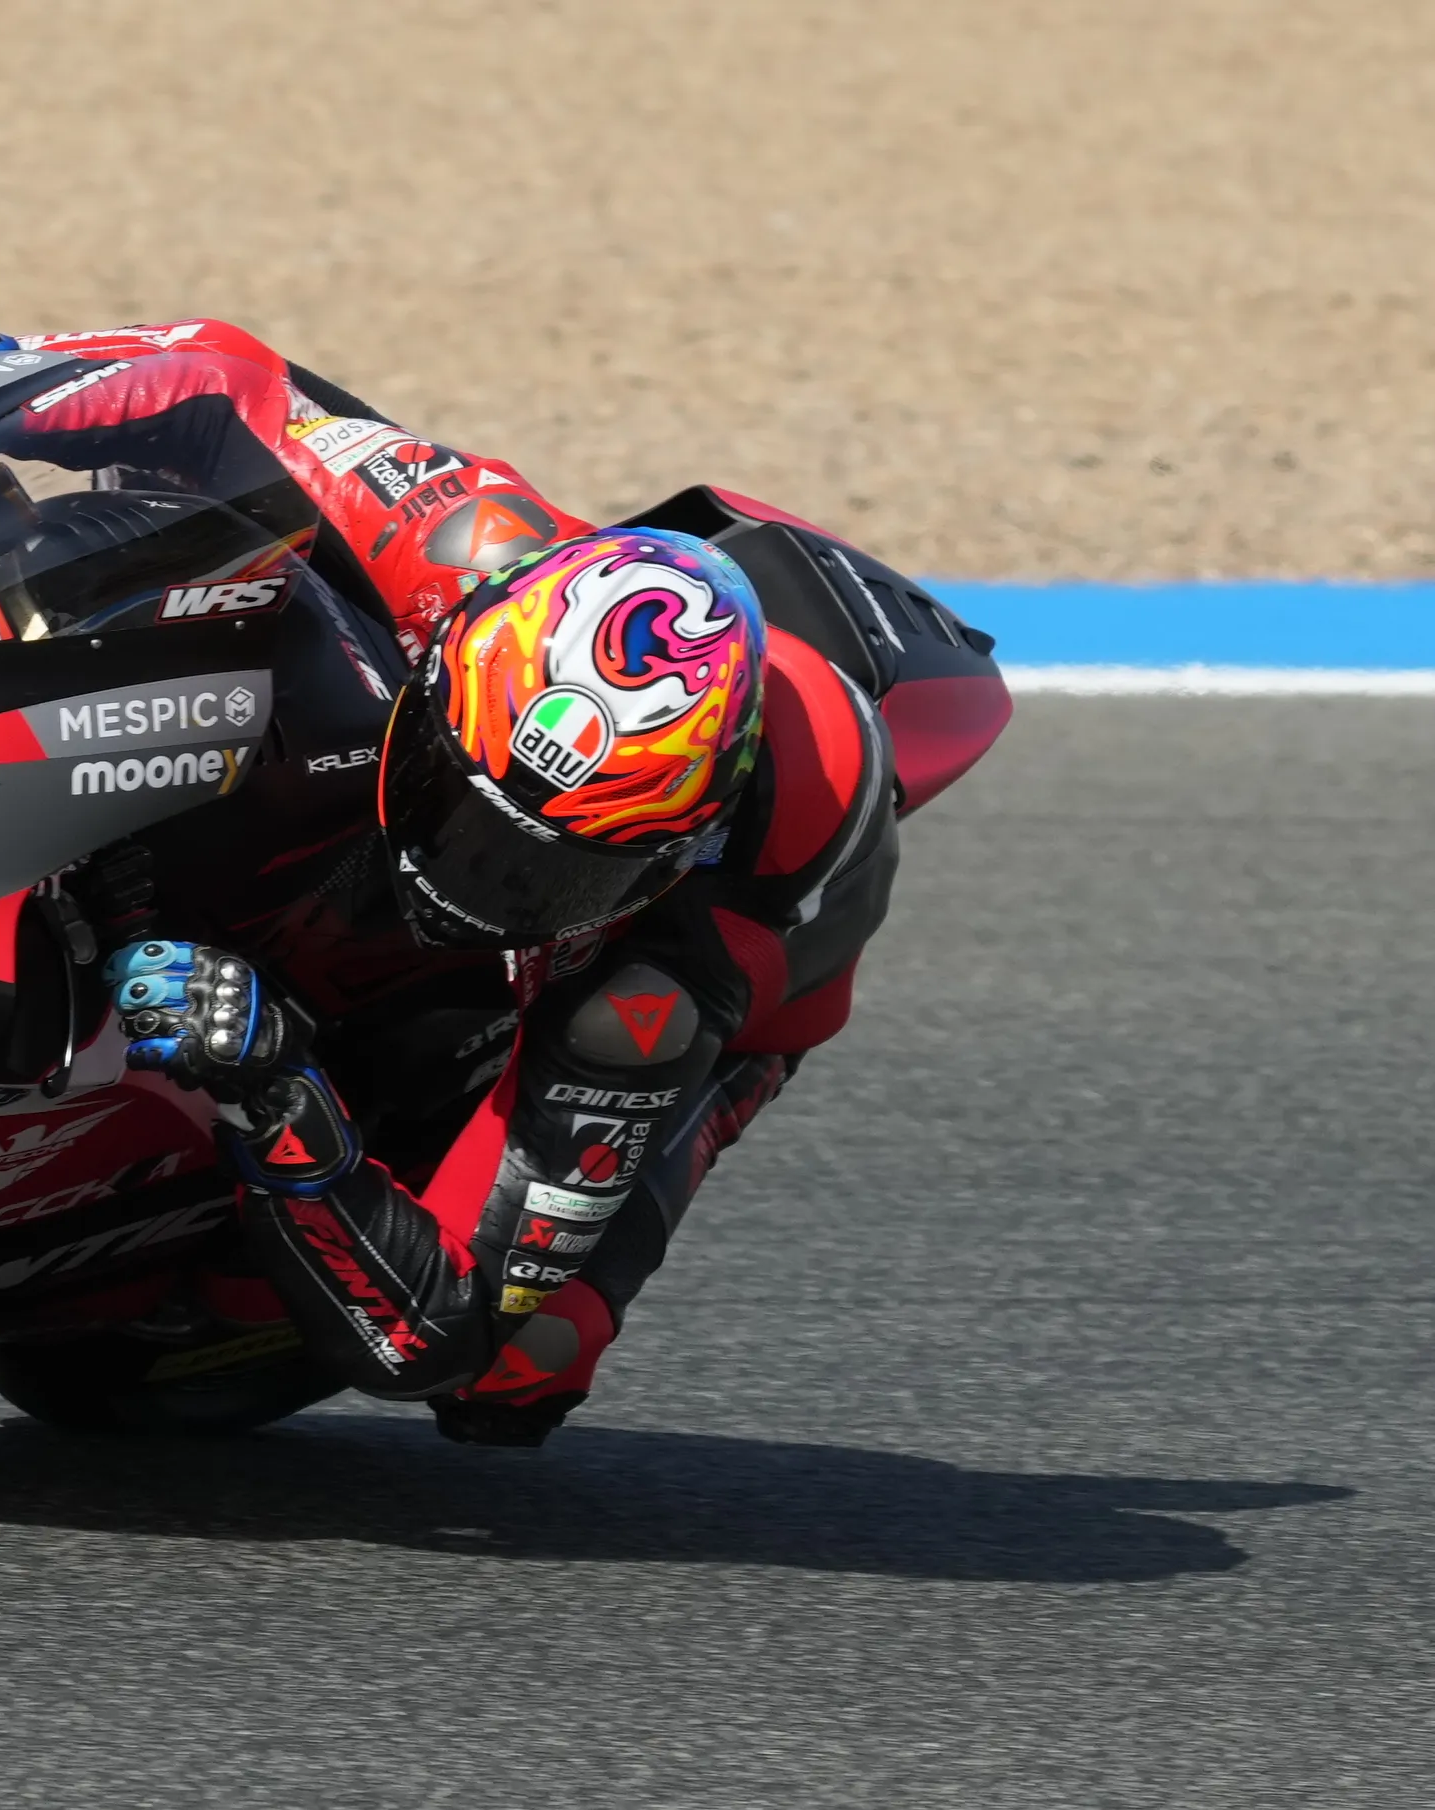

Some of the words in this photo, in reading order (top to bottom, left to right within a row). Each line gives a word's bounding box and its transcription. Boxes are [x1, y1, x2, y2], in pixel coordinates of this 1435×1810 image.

[32, 360, 132, 413] WRS
[161, 576, 286, 619] WRS
[59, 691, 219, 742] MESPIC
[71, 745, 248, 796] mooney
[522, 727, 583, 788] agv
[544, 1083, 682, 1110] DAINESE
